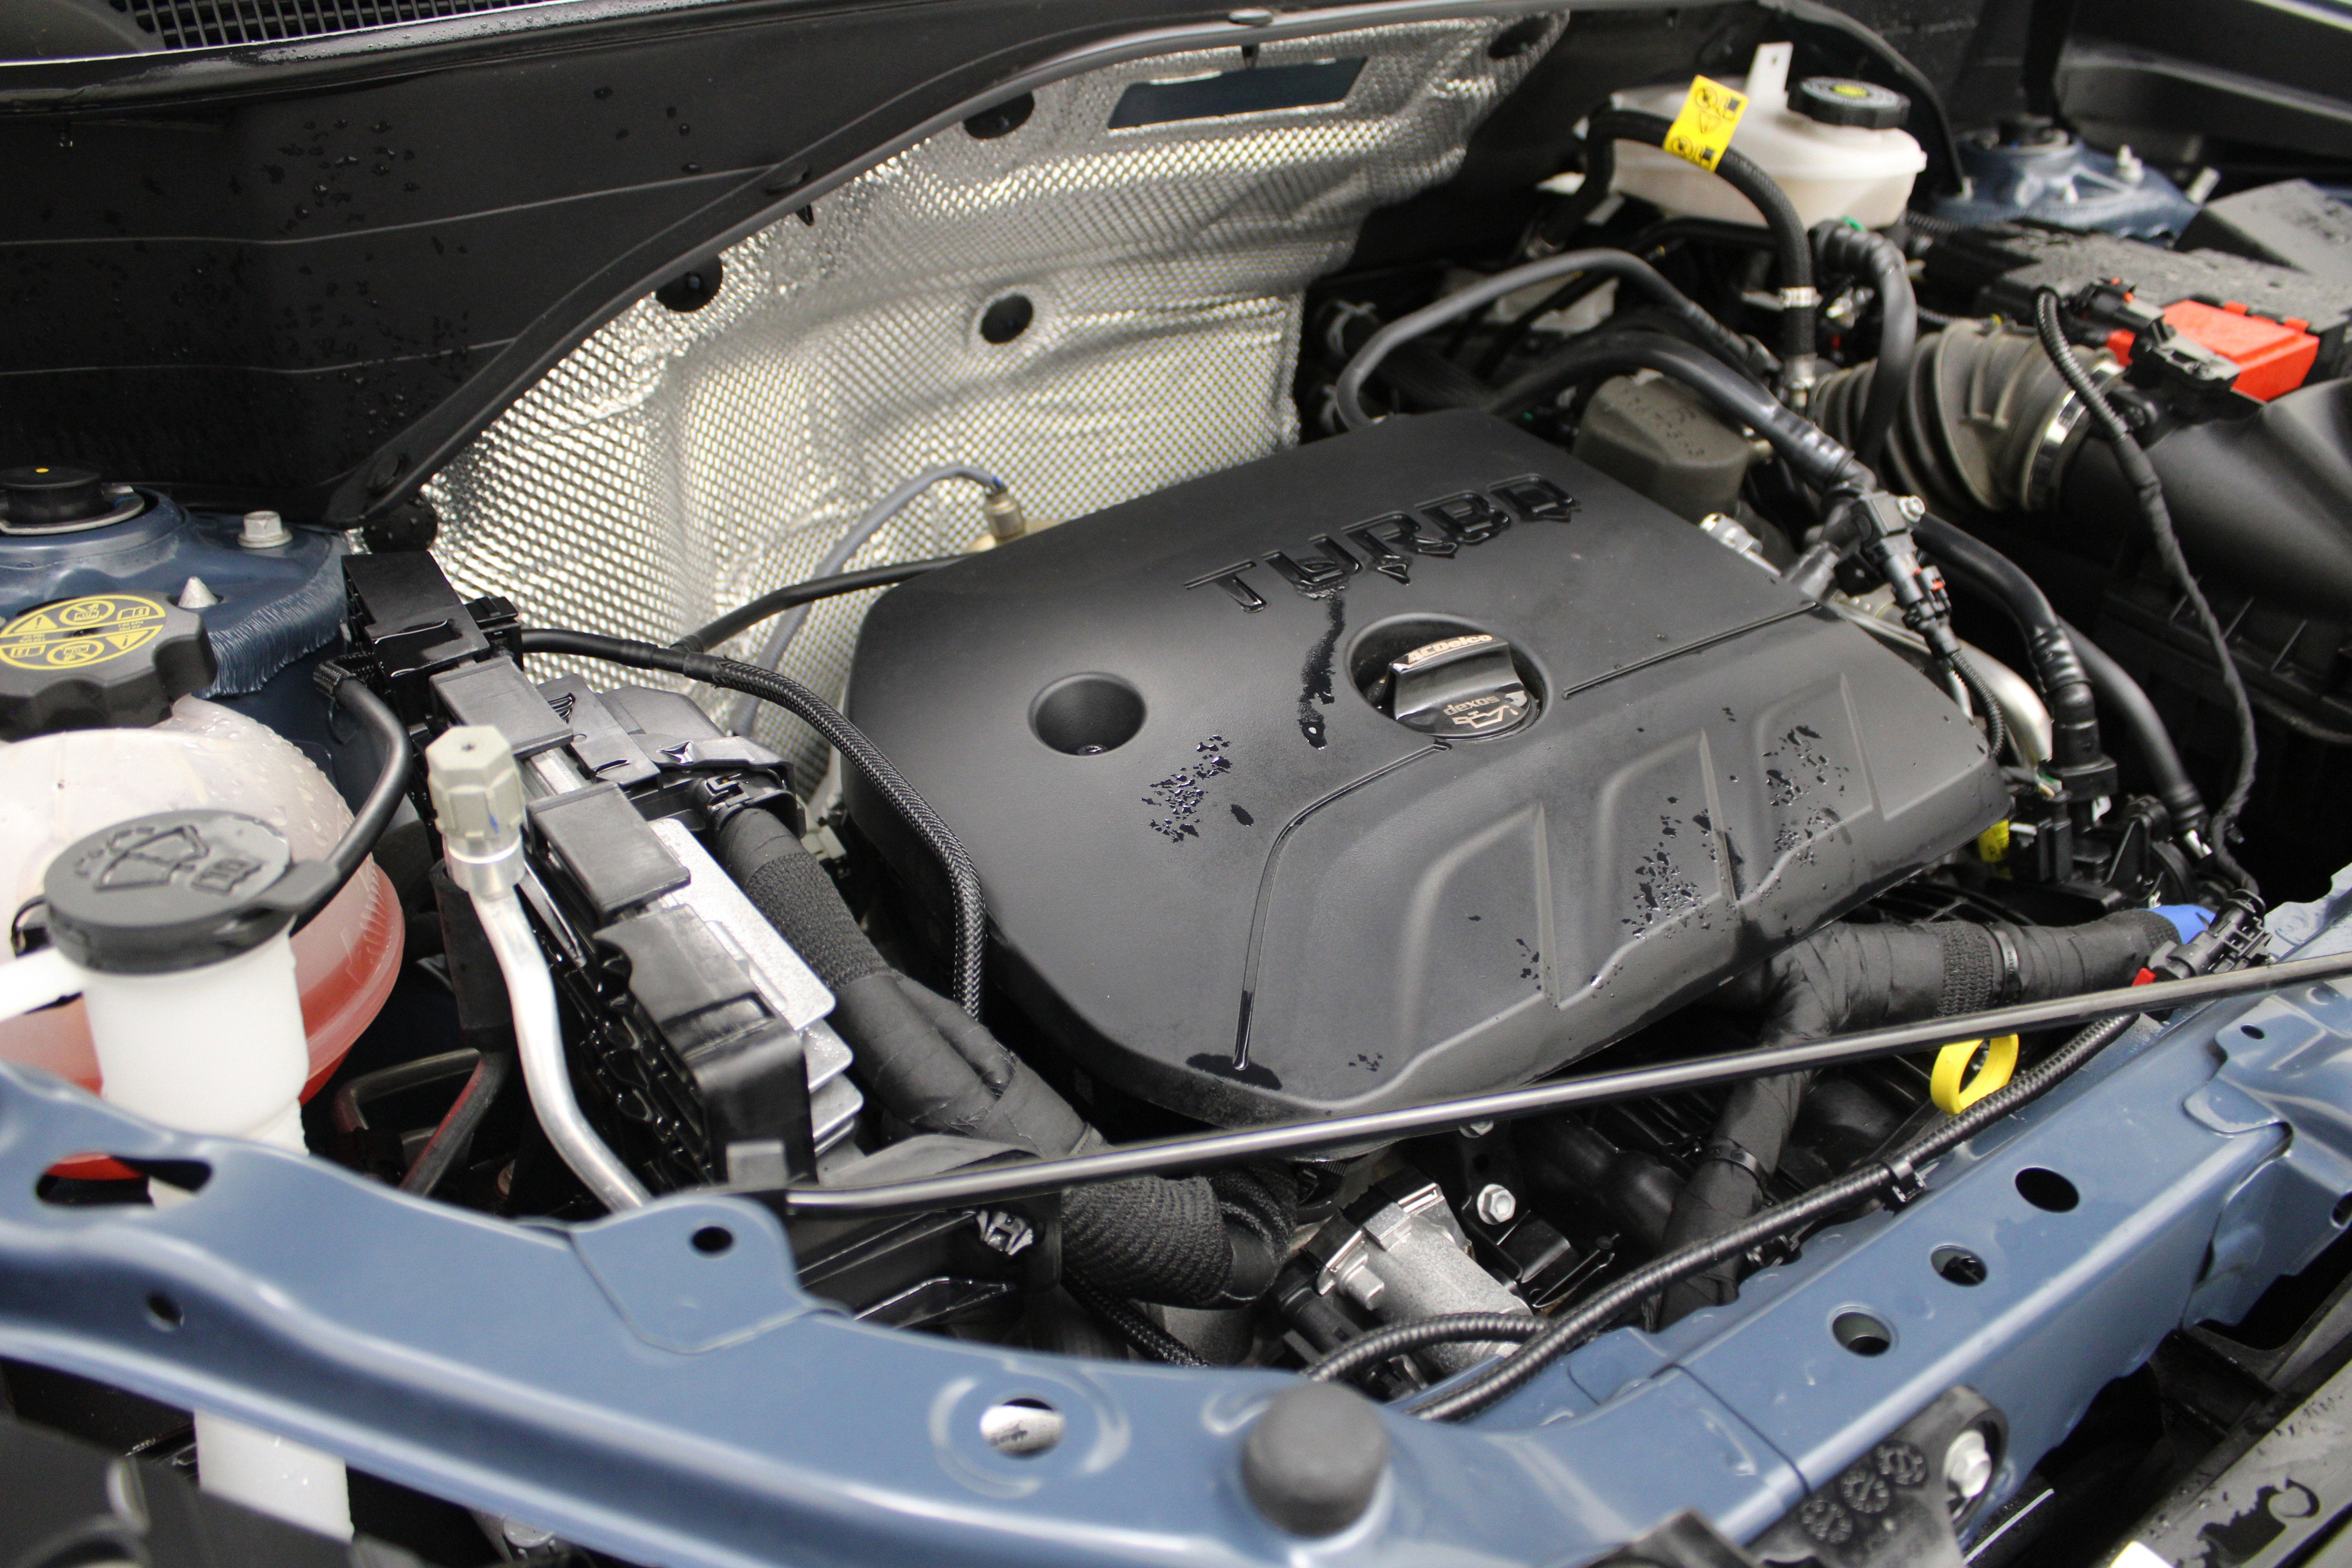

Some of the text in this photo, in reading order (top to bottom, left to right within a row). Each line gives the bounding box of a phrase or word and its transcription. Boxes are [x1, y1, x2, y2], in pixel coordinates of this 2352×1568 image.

[1184, 473, 1579, 612] TURBO
[1407, 634, 1493, 664] ACDelco
[1443, 695, 1501, 717] dexos
